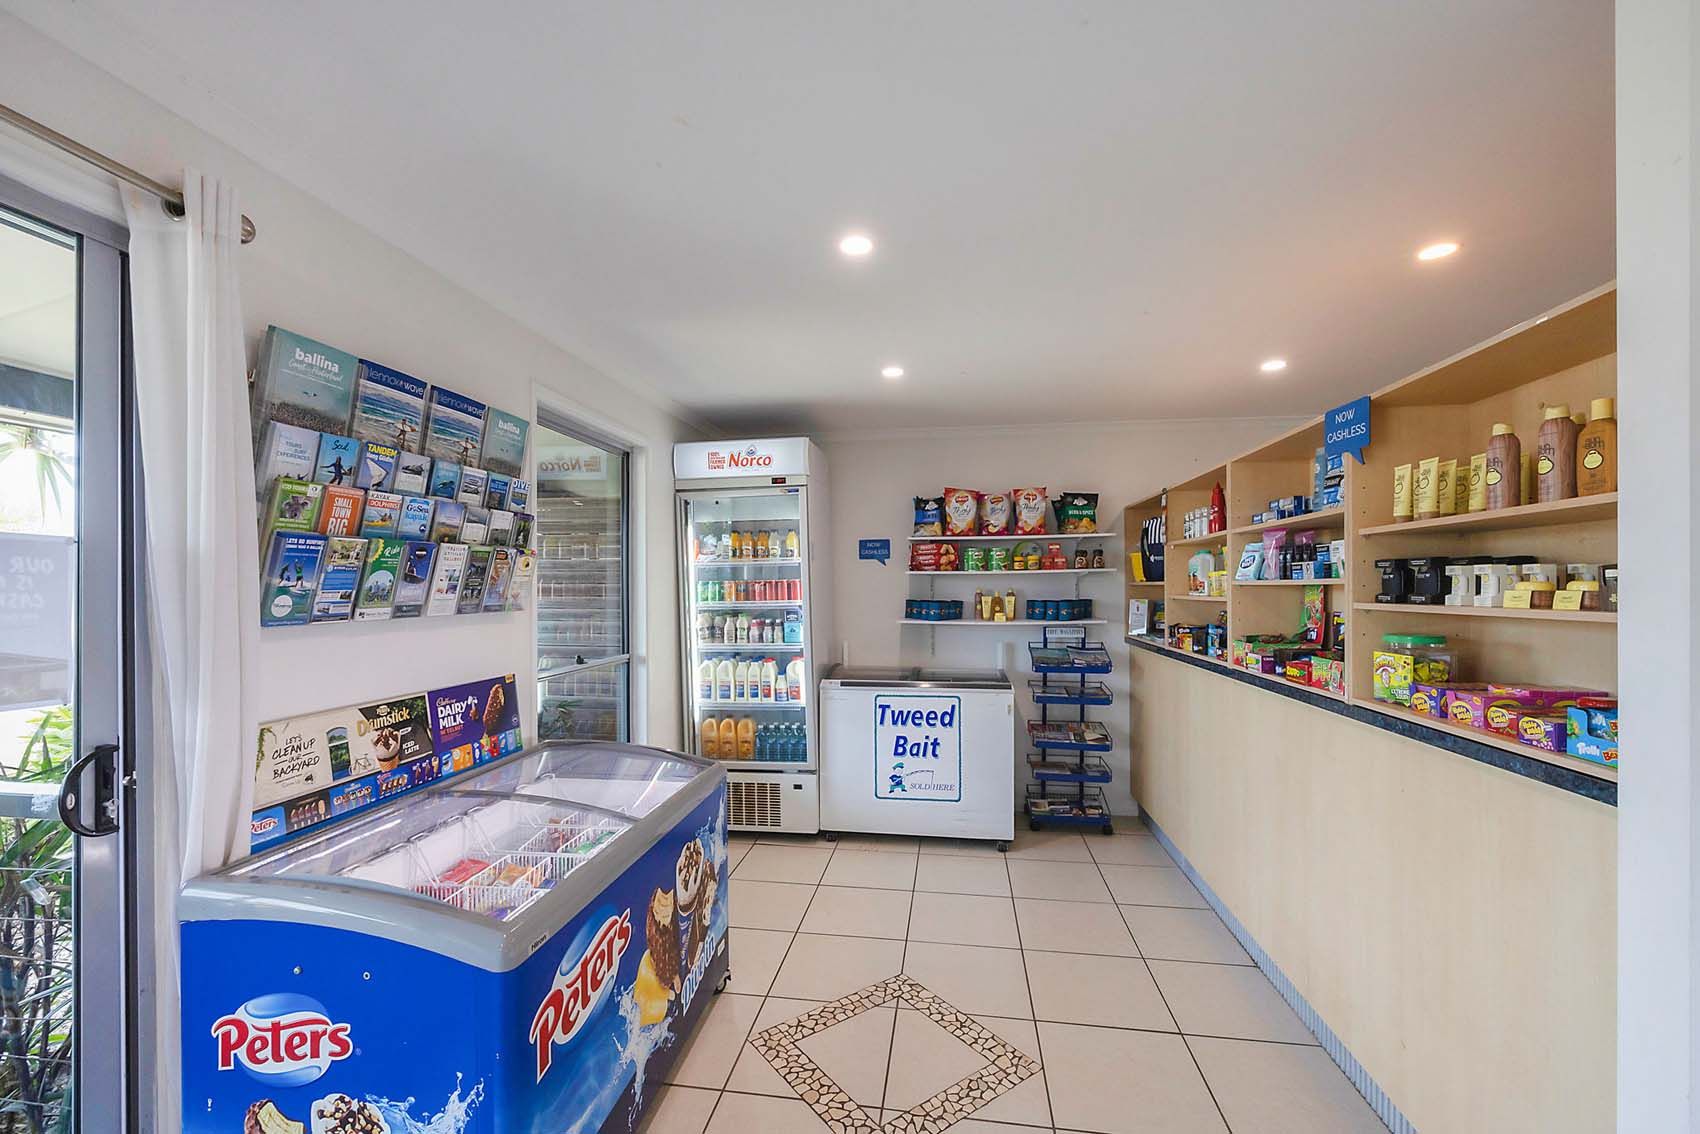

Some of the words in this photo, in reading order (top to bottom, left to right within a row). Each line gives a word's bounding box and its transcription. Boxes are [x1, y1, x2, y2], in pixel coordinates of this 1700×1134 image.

[295, 347, 340, 373] ballina
[1335, 408, 1355, 424] NOW
[1327, 423, 1366, 444] CASHLESS
[367, 443, 399, 457] TANDEM
[729, 452, 772, 467] Norco
[333, 496, 353, 508] SMALL
[331, 507, 352, 519] TOWN
[326, 517, 349, 536] BIG
[438, 701, 467, 718] DAIRY
[878, 704, 956, 727] Tweed
[356, 706, 411, 737] Drumstick
[440, 713, 464, 730] MILK
[272, 743, 302, 760] CLEAN
[303, 737, 316, 750] UP
[403, 740, 415, 750] ICED
[405, 745, 419, 755] LATTE
[893, 735, 940, 757] Bait
[272, 755, 320, 780] BACKYARD
[933, 783, 955, 791] HERE
[530, 910, 631, 1083] Peters
[212, 1016, 351, 1069] Peters
